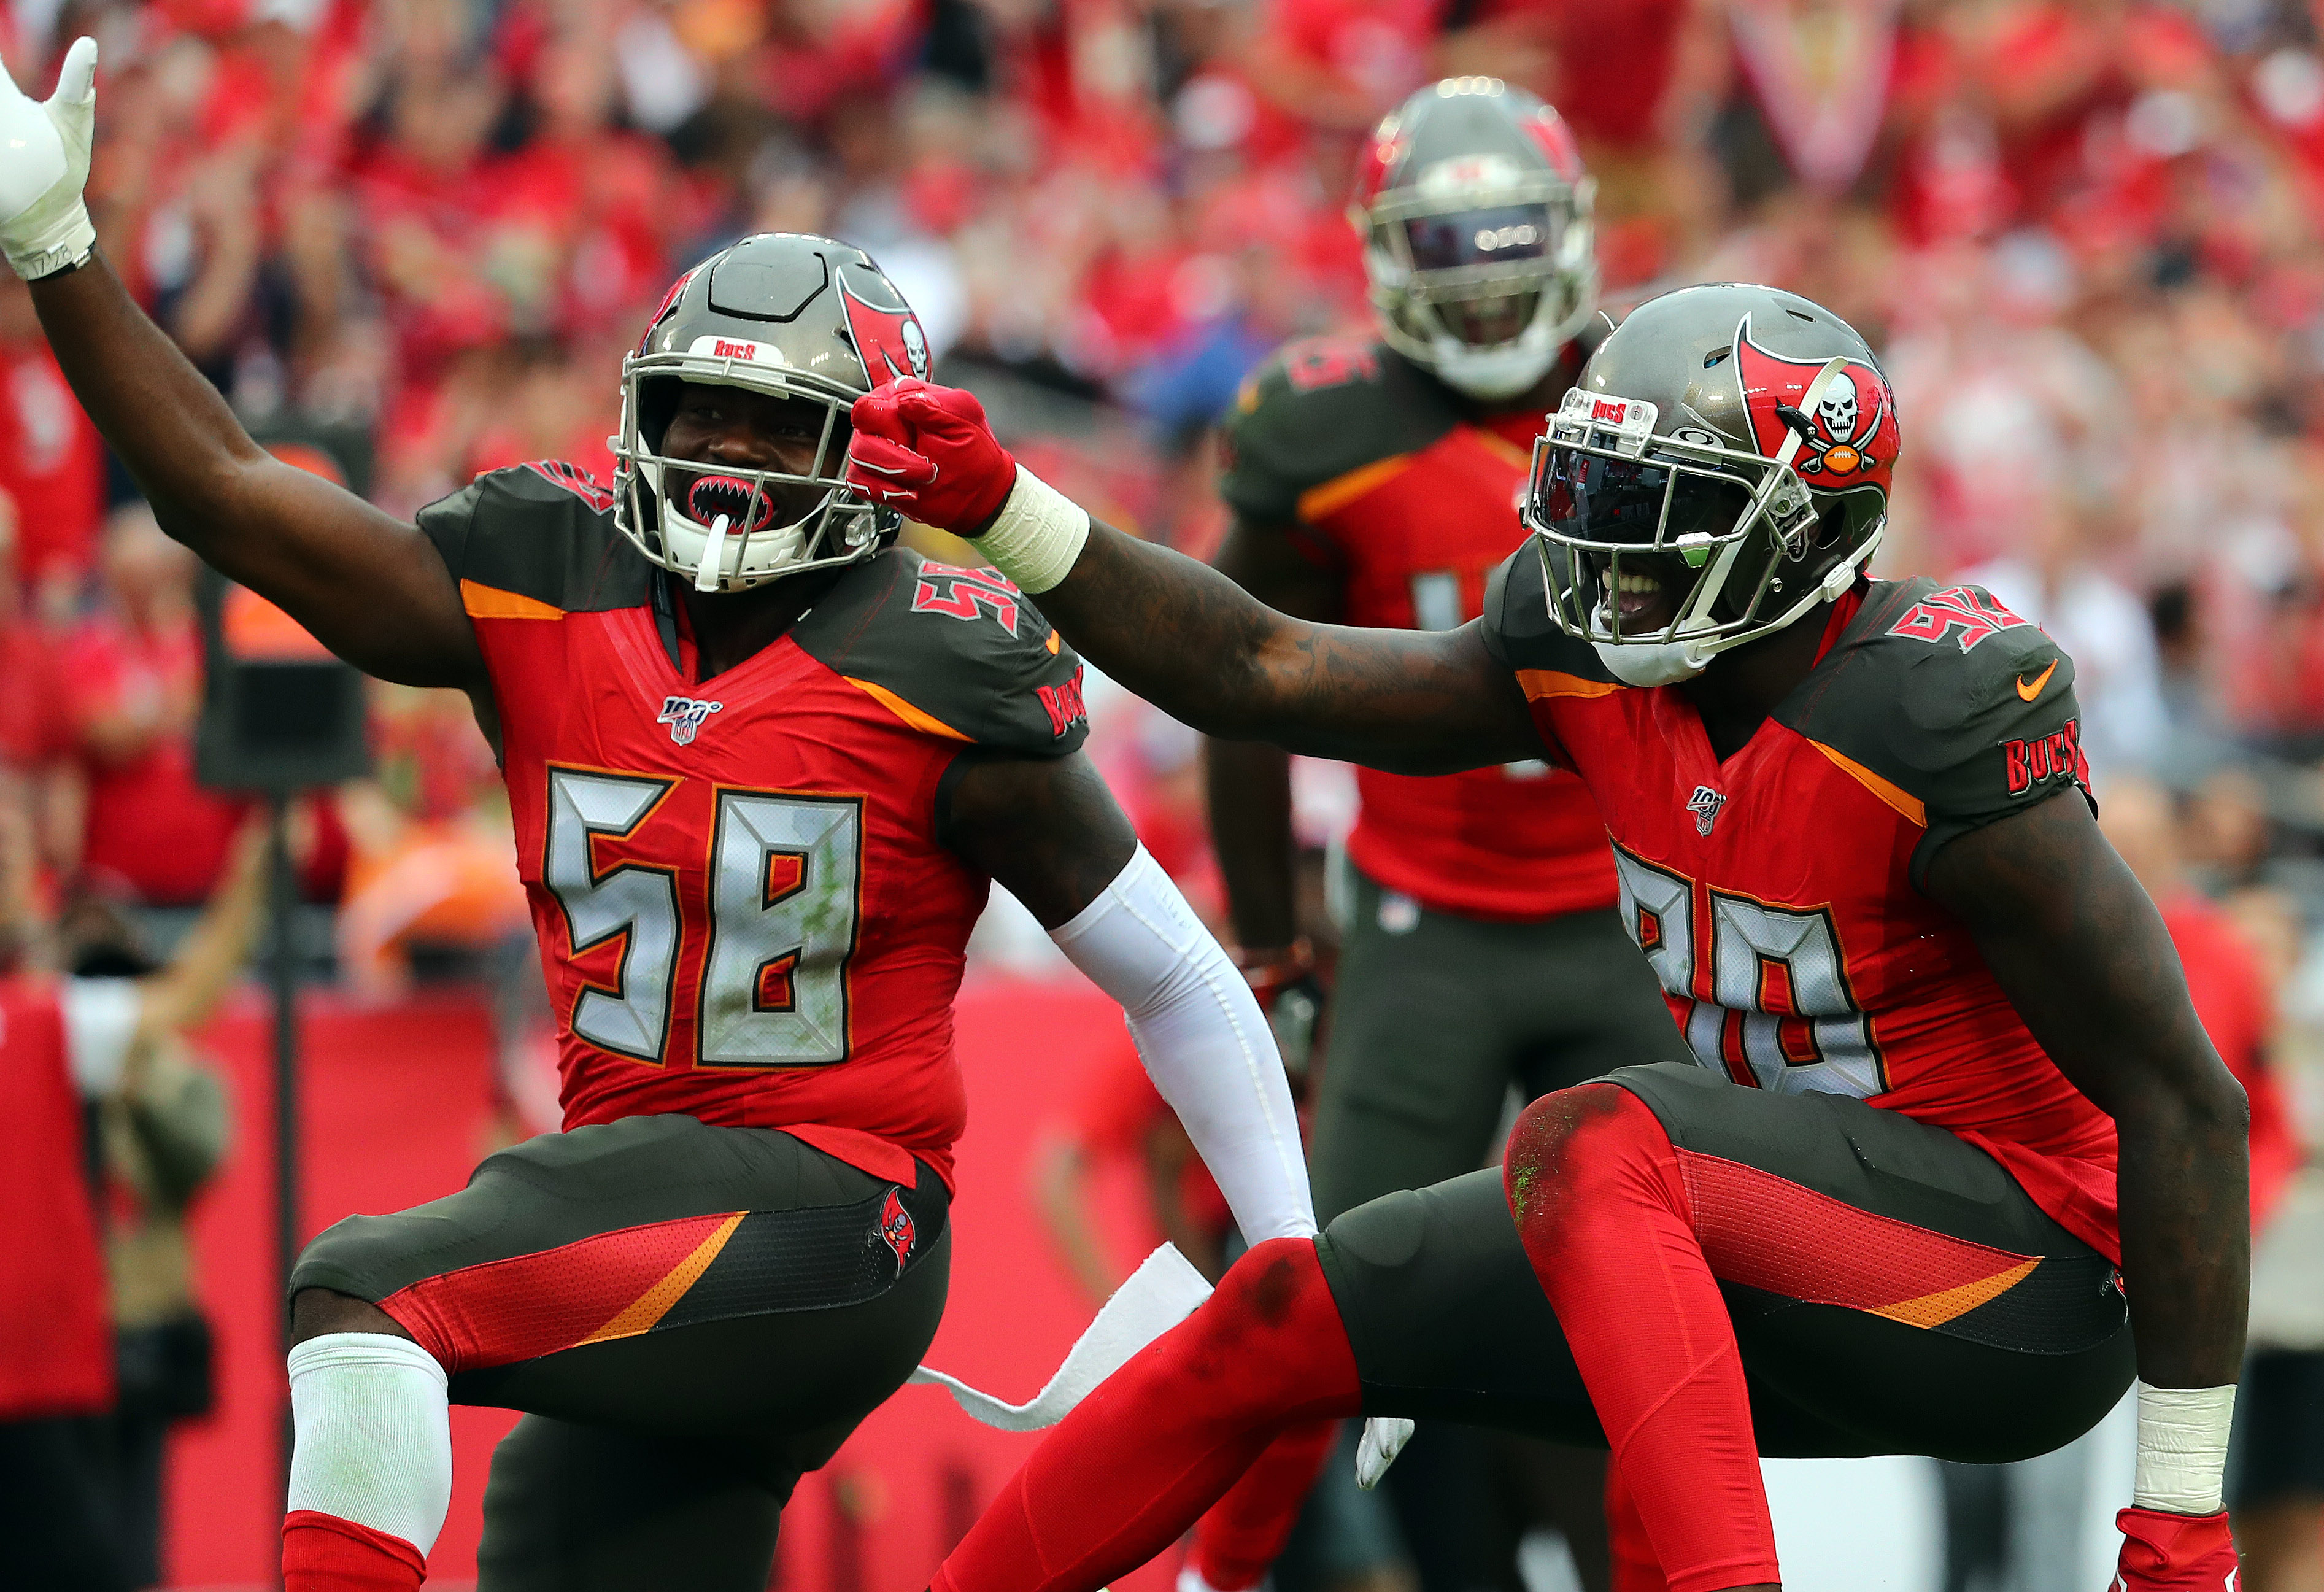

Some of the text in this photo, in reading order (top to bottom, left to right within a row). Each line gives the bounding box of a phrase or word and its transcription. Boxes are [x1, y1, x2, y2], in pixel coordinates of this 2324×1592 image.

[714, 339, 756, 361] BUCS
[1998, 717, 2079, 797] BUCS
[540, 759, 868, 1072] 58
